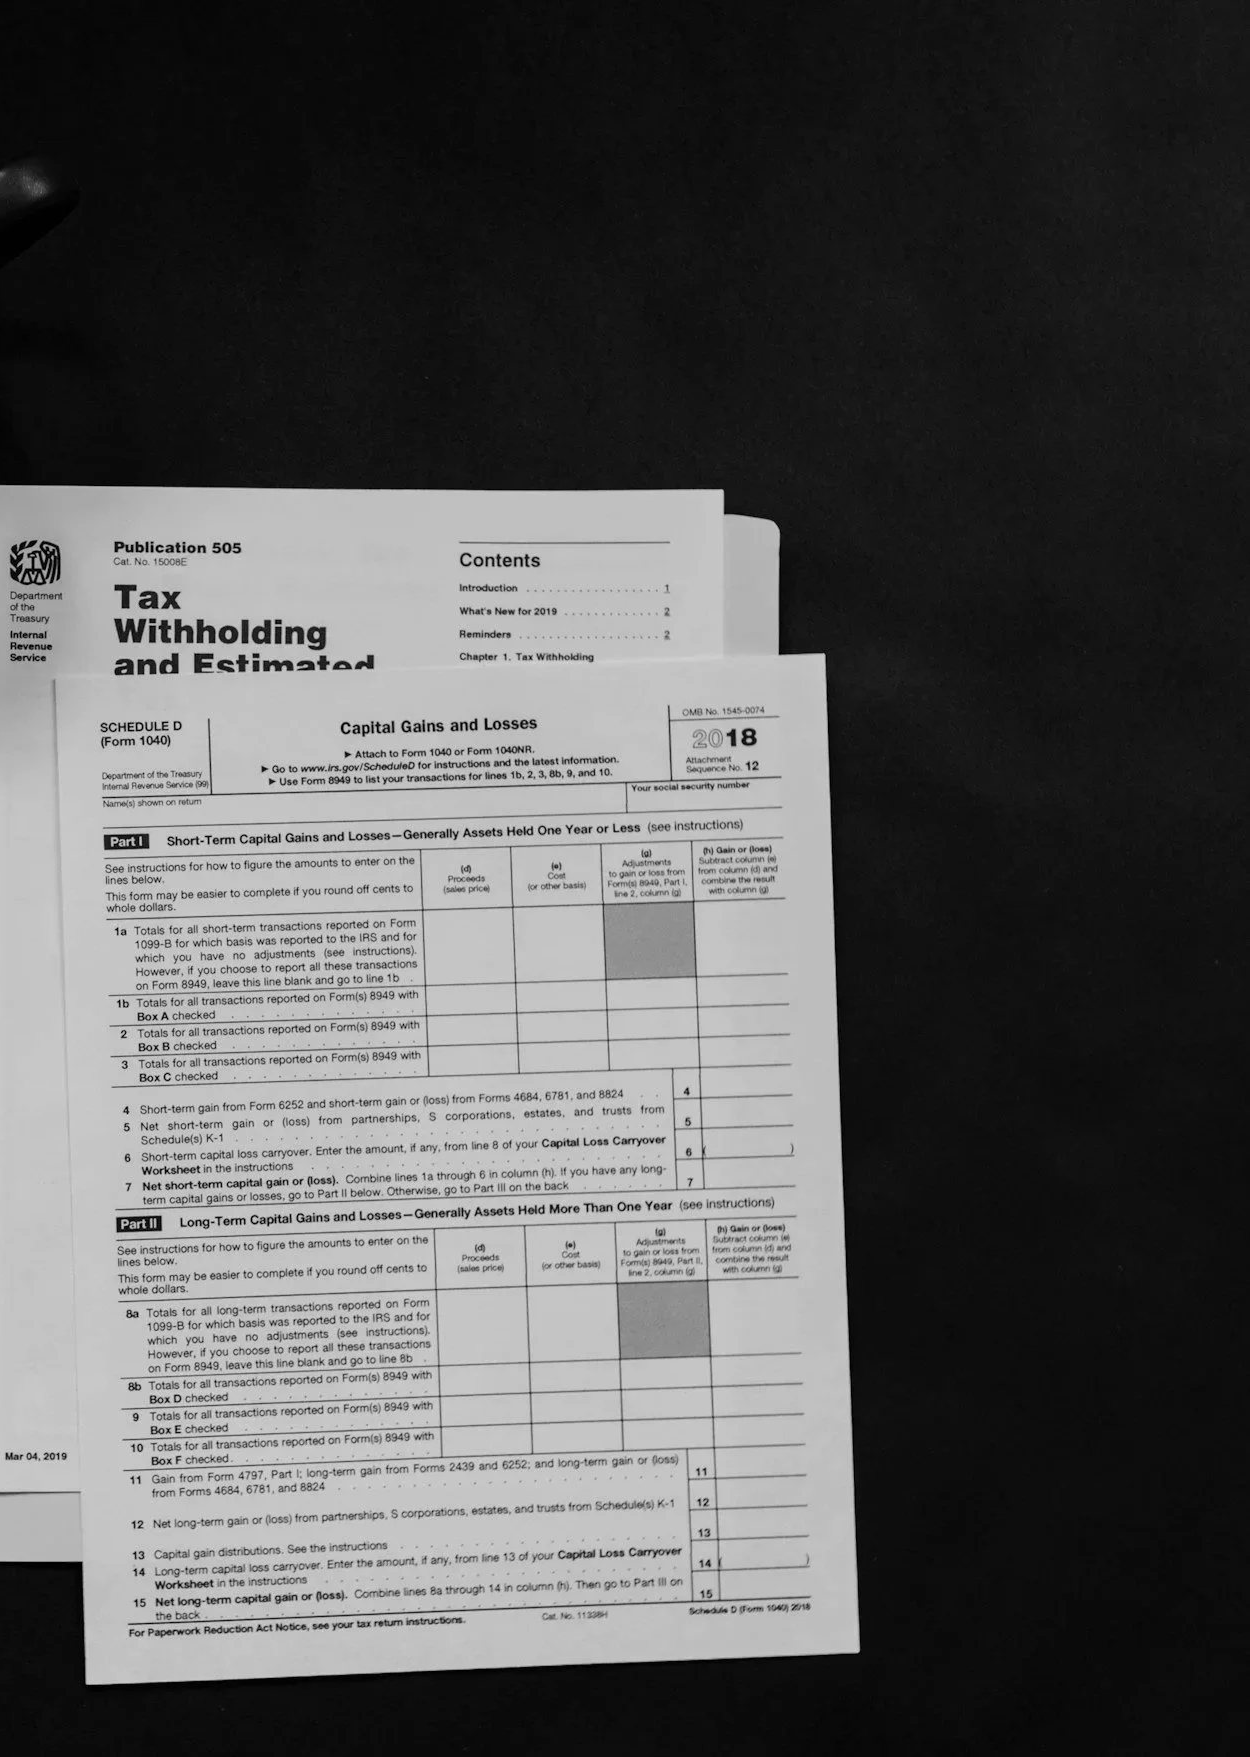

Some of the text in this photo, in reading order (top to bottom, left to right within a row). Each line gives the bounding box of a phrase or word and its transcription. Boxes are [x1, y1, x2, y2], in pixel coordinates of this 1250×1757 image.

[114, 541, 242, 554] Publication 505
[113, 557, 187, 566] Cat. No. 15008E
[460, 552, 541, 568] Contents
[459, 584, 518, 592] Introduction
[10, 591, 63, 601] Department
[114, 584, 181, 610] Tax
[10, 602, 35, 611] of the
[459, 607, 492, 616] What's
[495, 607, 516, 616] New
[518, 607, 532, 616] for
[534, 607, 557, 616] 2019
[10, 613, 50, 625] Treasury
[10, 630, 47, 639] Internal
[113, 618, 327, 651] Withholding
[459, 629, 511, 639] Reminders
[10, 641, 53, 651] Revenue
[10, 653, 46, 662] Service
[459, 652, 498, 663] Chapter
[515, 652, 533, 661] Tax
[536, 652, 594, 663] Withholding
[114, 653, 179, 676] and
[682, 706, 765, 717] OMB No. 1545-0074
[100, 720, 182, 733] SCHEDULE D
[340, 717, 538, 737] Capital Gains and Losses
[100, 735, 171, 749] (Form 1040)
[692, 727, 758, 749] 2018
[685, 756, 732, 764] Attachment
[686, 760, 760, 774] Sequence No. 12
[167, 835, 236, 847] Short-Term
[239, 833, 282, 846] Capital
[285, 832, 319, 843] Gains
[322, 831, 345, 843] and
[462, 827, 503, 838] Assets
[506, 825, 534, 837] Held
[537, 825, 562, 836] One
[565, 824, 593, 835] Year
[596, 825, 609, 834] or
[612, 823, 641, 833] Less
[647, 822, 671, 834] (see
[674, 819, 743, 831] instructions)
[110, 836, 143, 850] Part I
[105, 875, 165, 885] lines below.
[141, 1162, 294, 1176] Worksheet in the instructions
[180, 1216, 247, 1230] Long-Term
[250, 1213, 293, 1227] Capital
[295, 1212, 330, 1224] Gains
[333, 1211, 356, 1222] and
[474, 1206, 515, 1217] Assets
[518, 1204, 545, 1215] Held
[549, 1204, 580, 1214] More
[583, 1202, 613, 1213] Than
[617, 1201, 642, 1212] One
[645, 1200, 673, 1211] Year
[679, 1200, 703, 1211] (see
[706, 1197, 775, 1209] instructions)
[120, 1217, 157, 1230] Part II
[5, 1452, 67, 1461] Mar 04, 2019
[151, 1481, 325, 1498] from Forms 4684, 6781, and 8824
